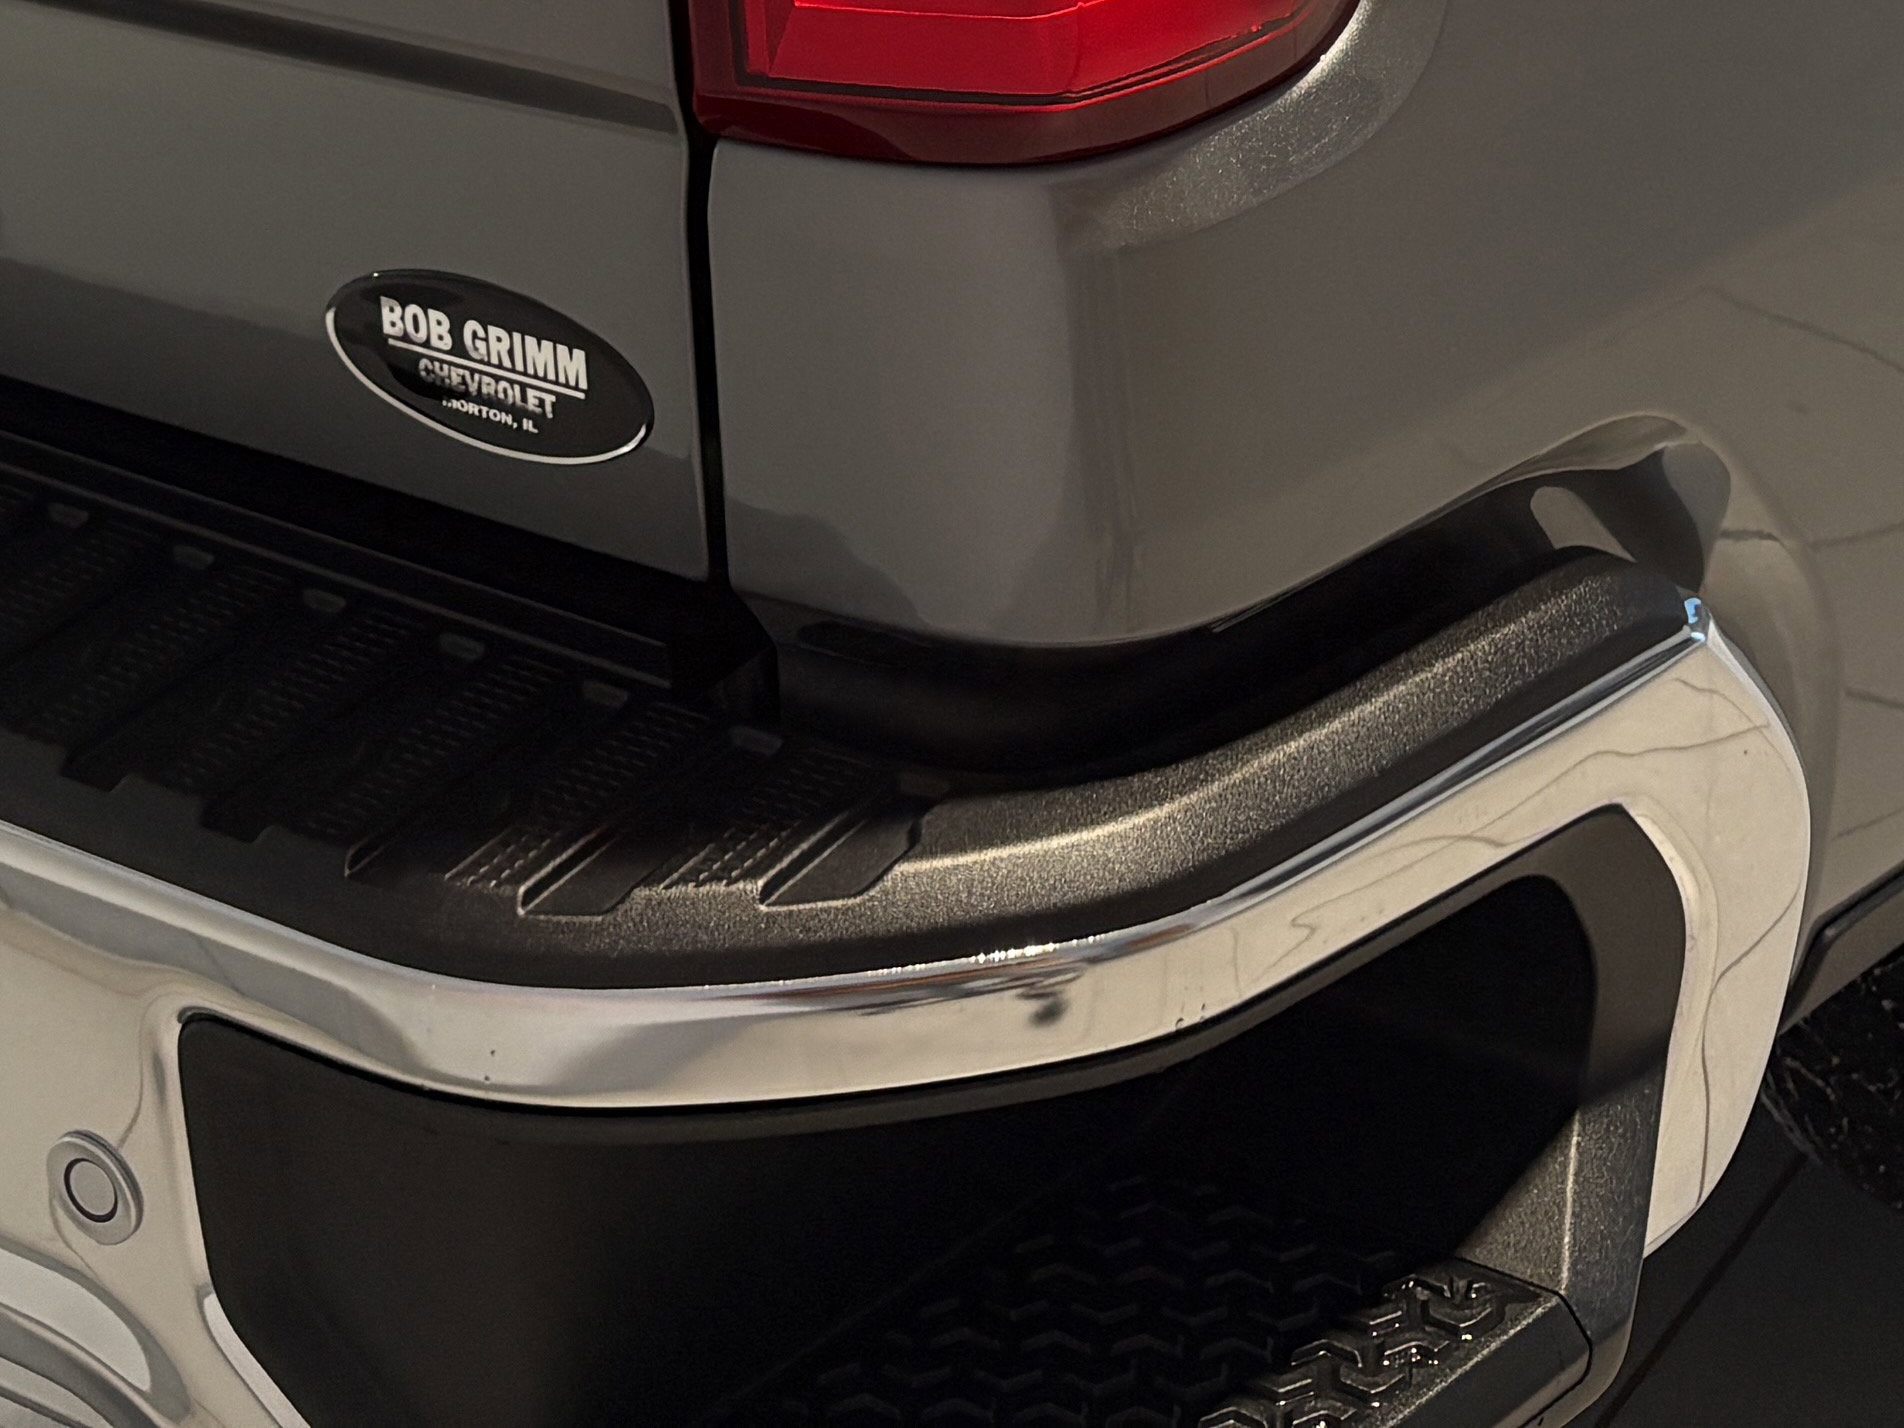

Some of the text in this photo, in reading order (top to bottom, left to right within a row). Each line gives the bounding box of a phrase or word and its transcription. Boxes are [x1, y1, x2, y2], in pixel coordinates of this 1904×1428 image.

[379, 294, 589, 391] BOB GRIMM
[417, 357, 556, 419] CHEVROLET
[522, 417, 539, 434] IL
